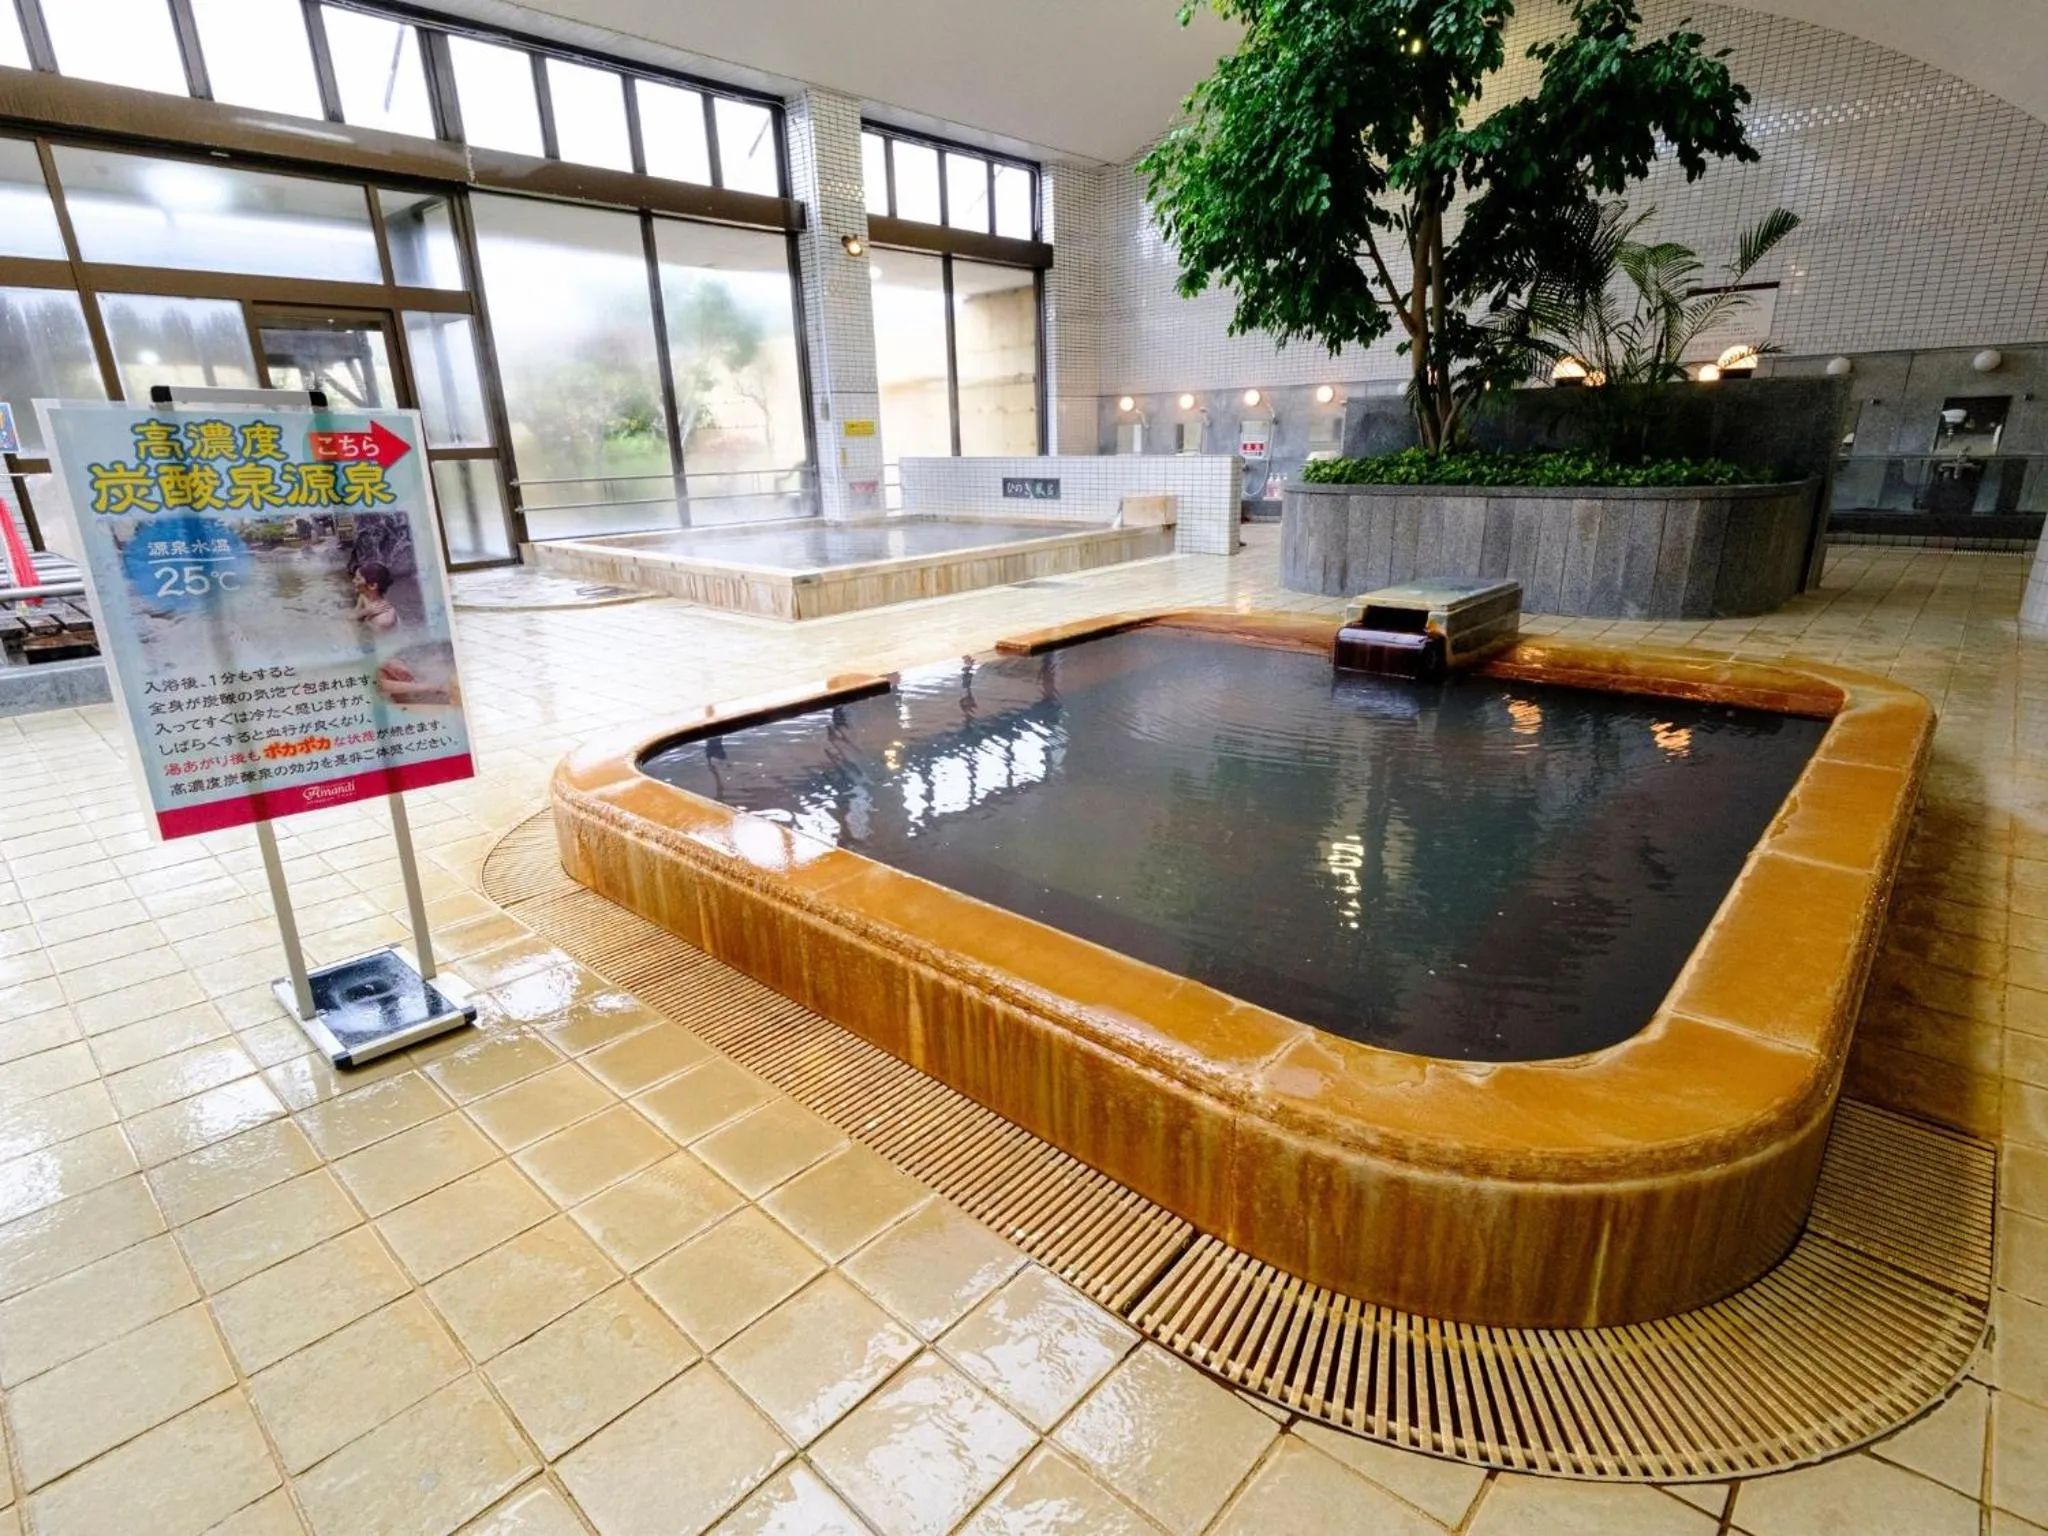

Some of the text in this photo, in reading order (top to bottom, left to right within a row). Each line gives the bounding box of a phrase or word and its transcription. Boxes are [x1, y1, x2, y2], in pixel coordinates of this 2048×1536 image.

[130, 419, 288, 460] 高濃度
[317, 436, 380, 457] こちら
[88, 460, 398, 513] 炭酸泉源泉
[147, 538, 232, 557] 源泉水温
